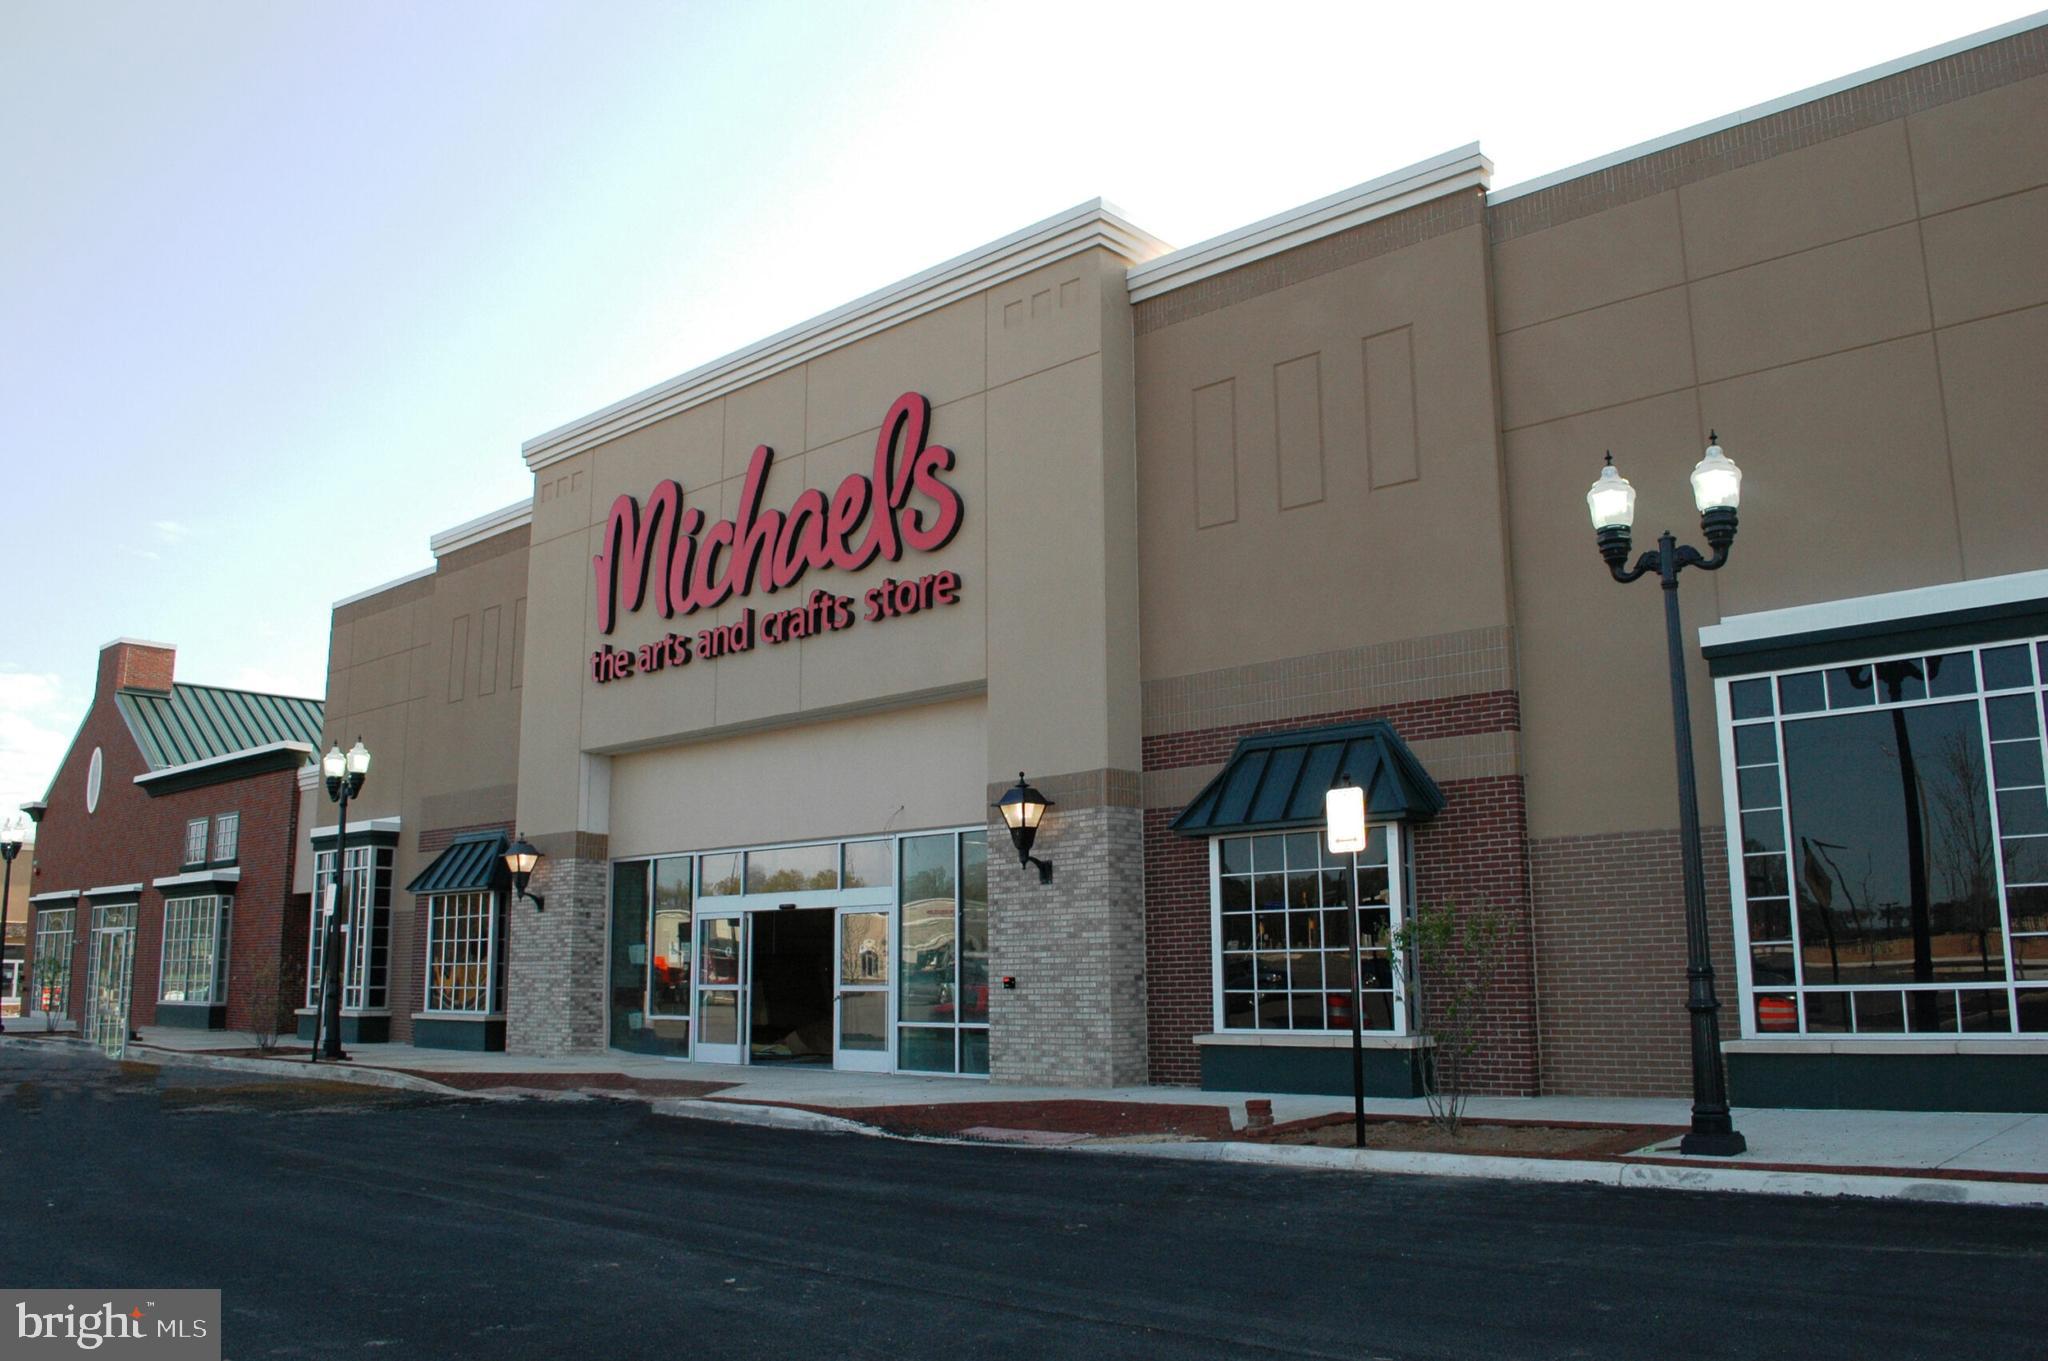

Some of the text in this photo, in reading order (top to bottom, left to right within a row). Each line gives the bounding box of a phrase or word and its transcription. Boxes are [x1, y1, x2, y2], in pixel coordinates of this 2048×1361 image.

[593, 391, 964, 635] Michaels
[591, 570, 962, 683] the arts and crafts store
